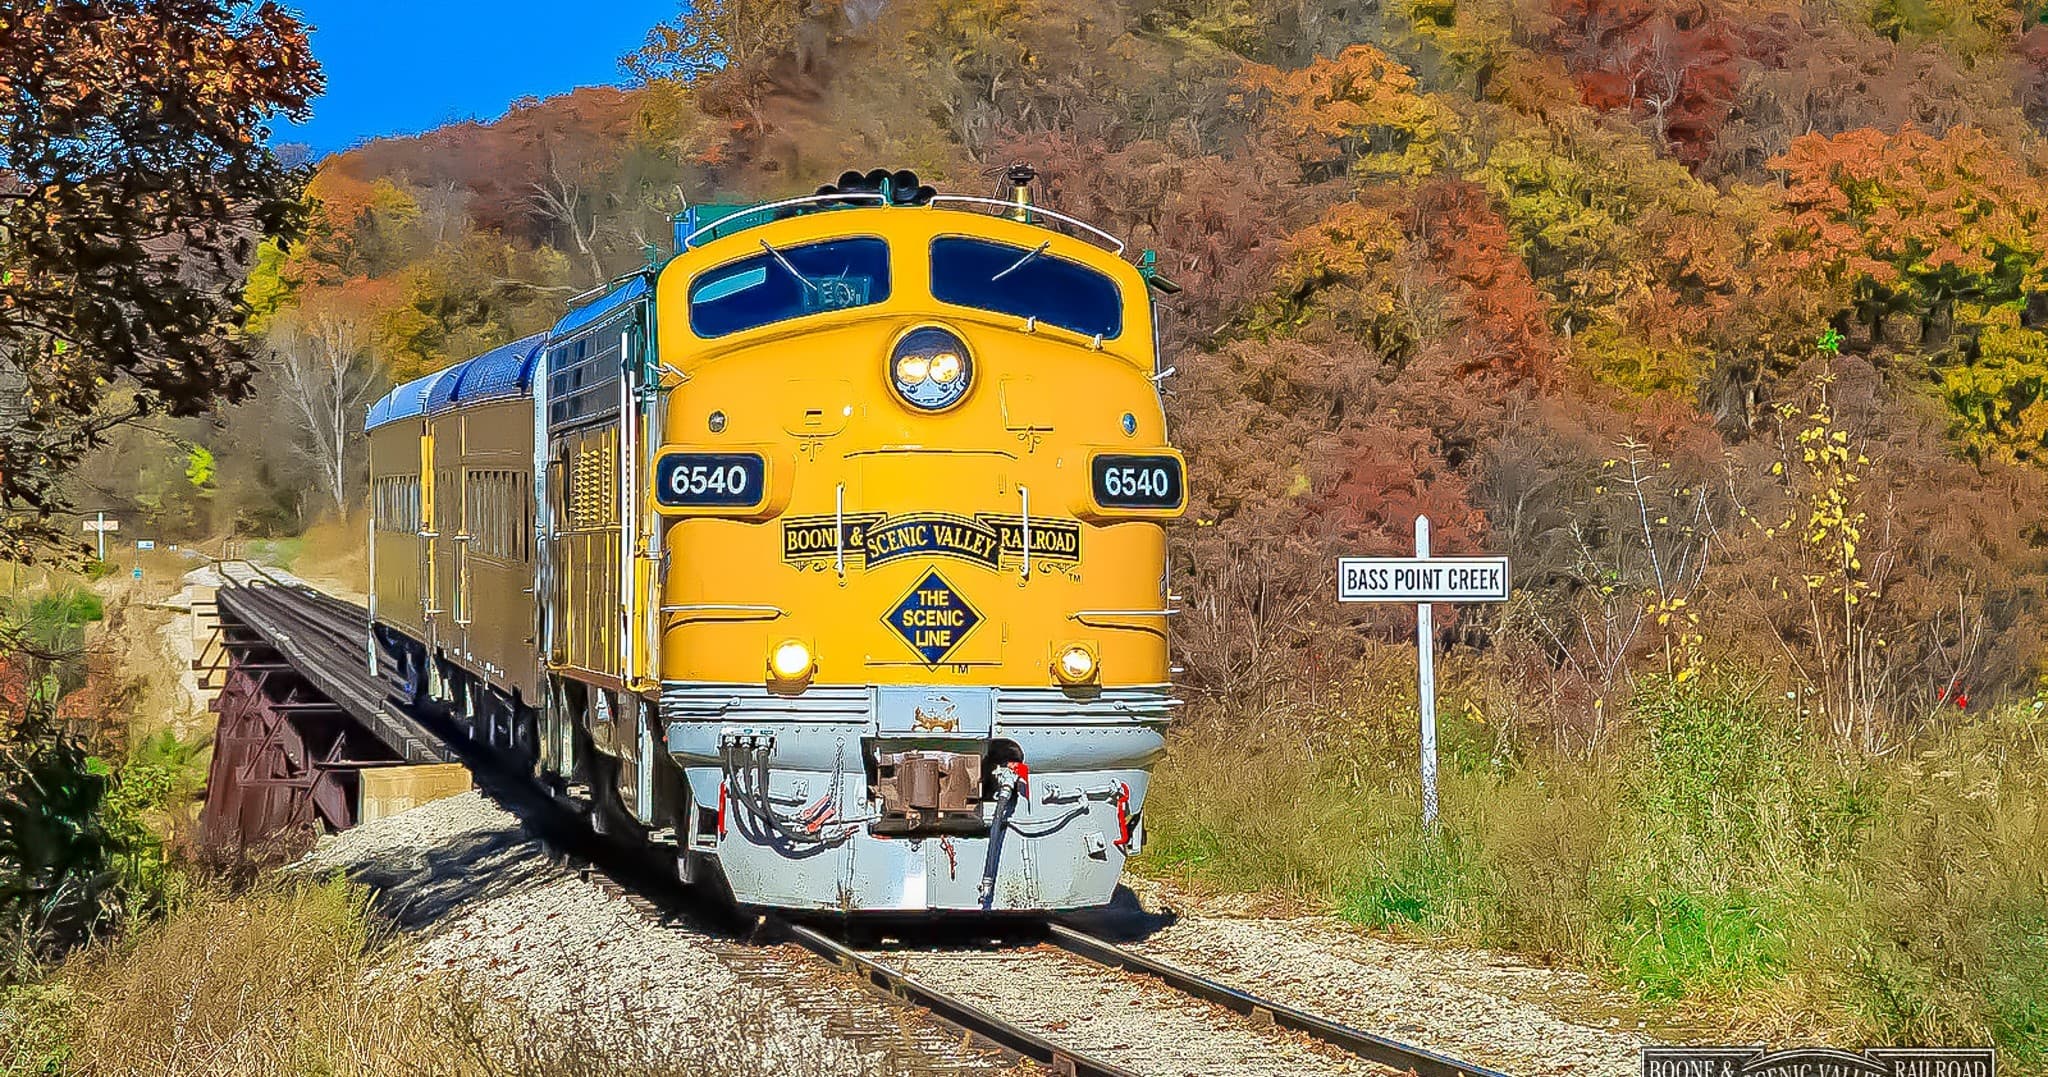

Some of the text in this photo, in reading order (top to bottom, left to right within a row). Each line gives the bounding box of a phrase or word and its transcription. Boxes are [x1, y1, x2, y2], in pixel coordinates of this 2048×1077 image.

[671, 464, 747, 495] 6540
[1104, 467, 1169, 497] 6540
[849, 526, 863, 547] &
[866, 525, 929, 558] SCENIC
[933, 525, 996, 558] VALLEY
[1000, 527, 1076, 553] RALROAD
[1068, 573, 1081, 583] TM
[1347, 568, 1500, 591] BASS POINT CREEK
[917, 589, 950, 606] THE
[902, 609, 965, 627] SCENIC
[915, 630, 951, 647] LINE
